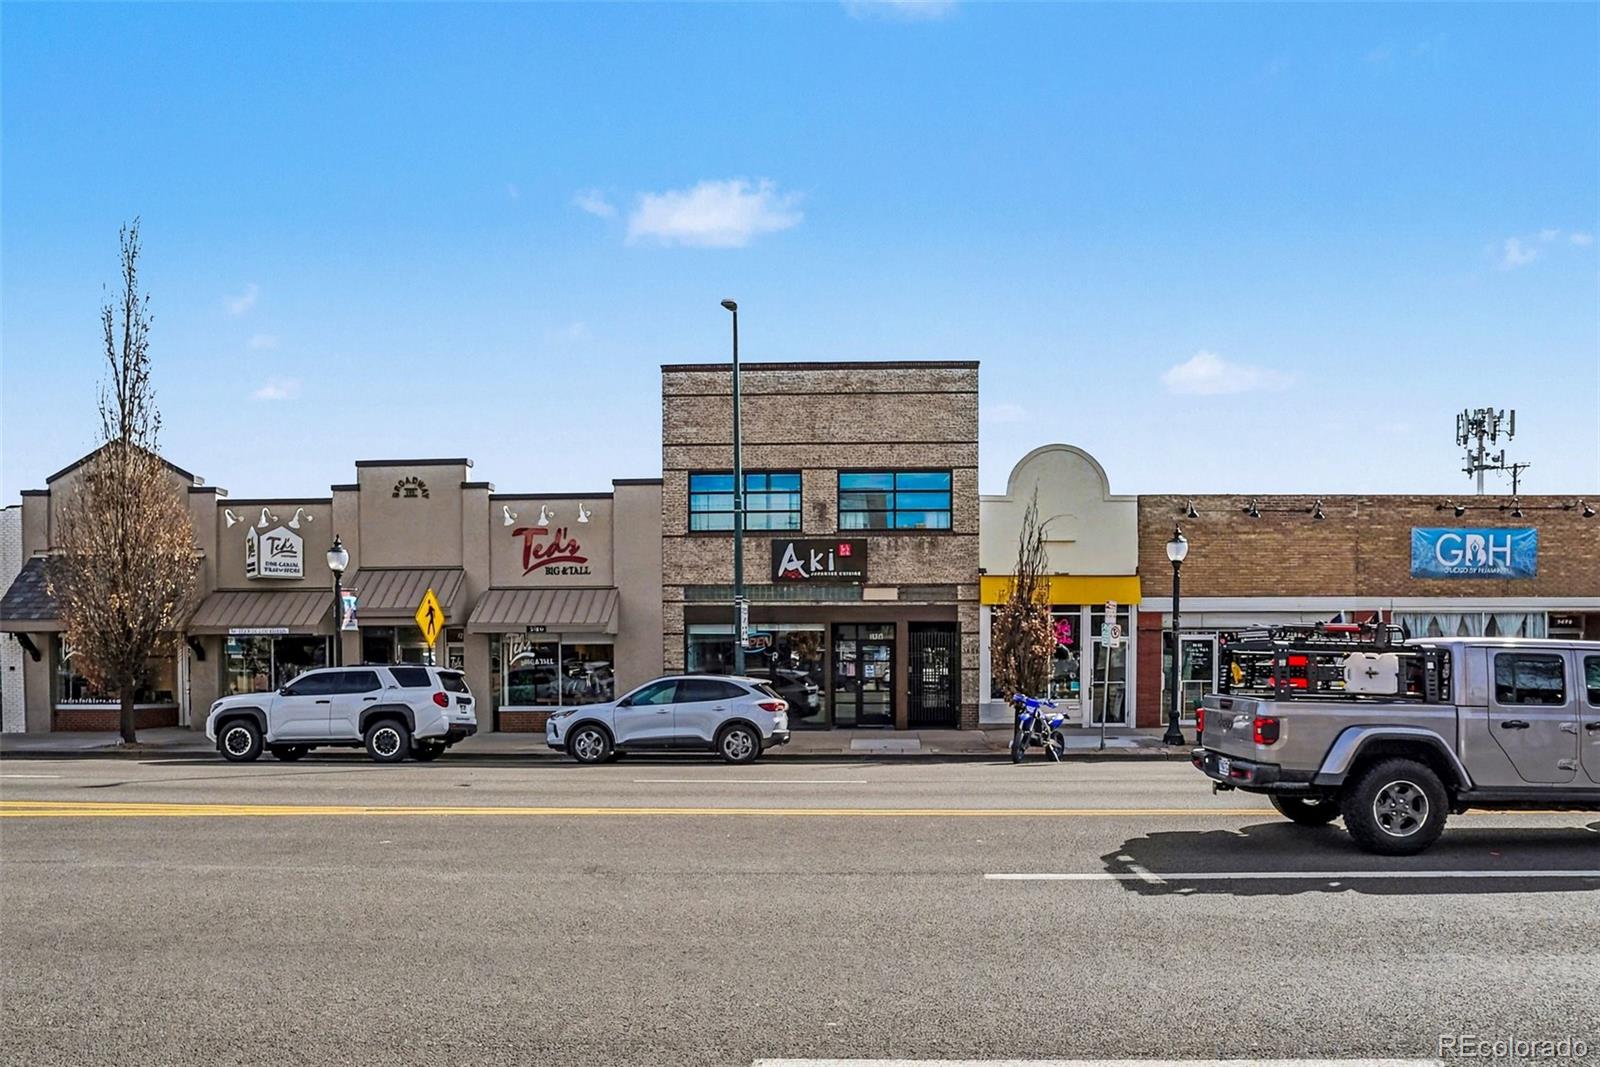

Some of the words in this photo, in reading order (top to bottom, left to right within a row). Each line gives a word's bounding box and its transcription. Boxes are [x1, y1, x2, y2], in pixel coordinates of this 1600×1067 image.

[391, 476, 430, 500] BROADWAY
[512, 527, 582, 571] Ted's
[778, 542, 835, 578] Aki
[1435, 533, 1512, 567] GBH
[545, 566, 560, 576] BIG
[561, 566, 569, 576] &
[569, 566, 591, 576] TALL
